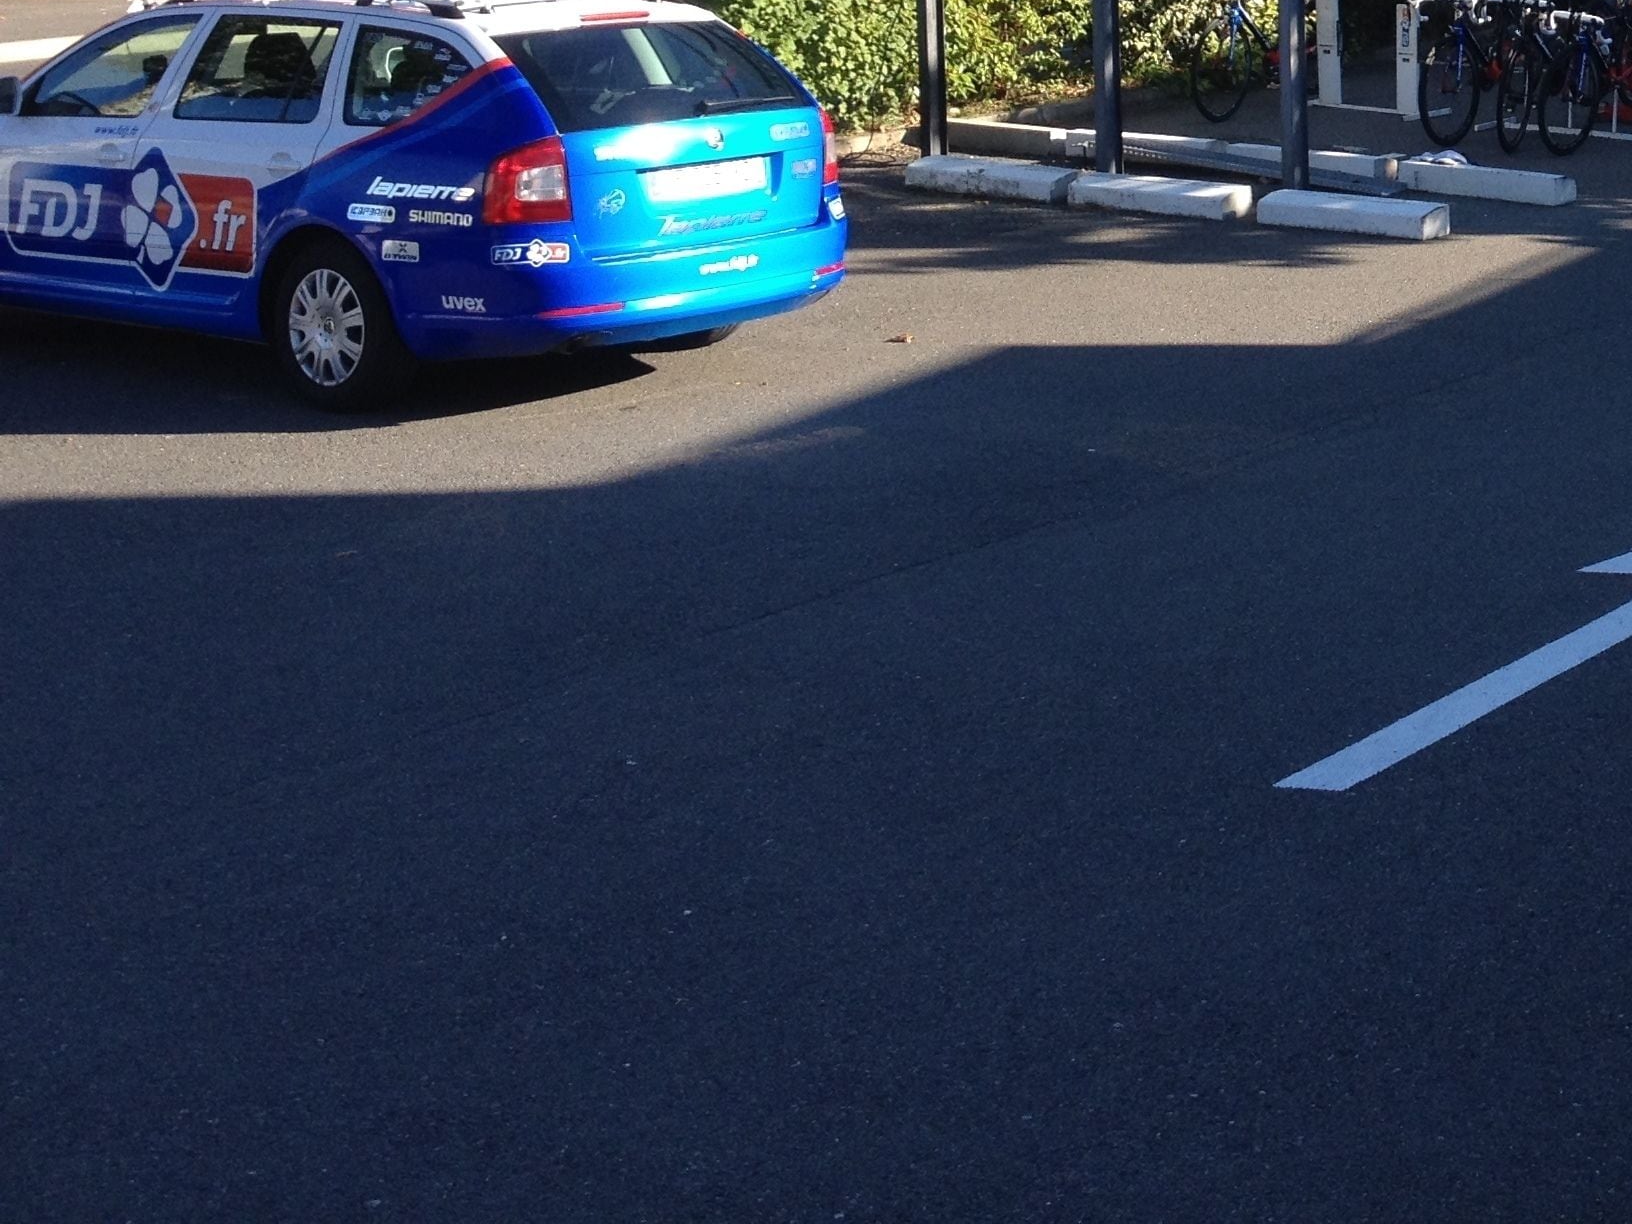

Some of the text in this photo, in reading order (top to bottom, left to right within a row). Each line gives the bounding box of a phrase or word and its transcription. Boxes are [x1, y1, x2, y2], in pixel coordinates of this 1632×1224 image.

[366, 176, 476, 202] lapierre
[16, 178, 246, 251] FDJ .fr
[409, 209, 473, 227] SHIMANO
[494, 247, 522, 261] FDJ
[441, 294, 487, 313] uvex
